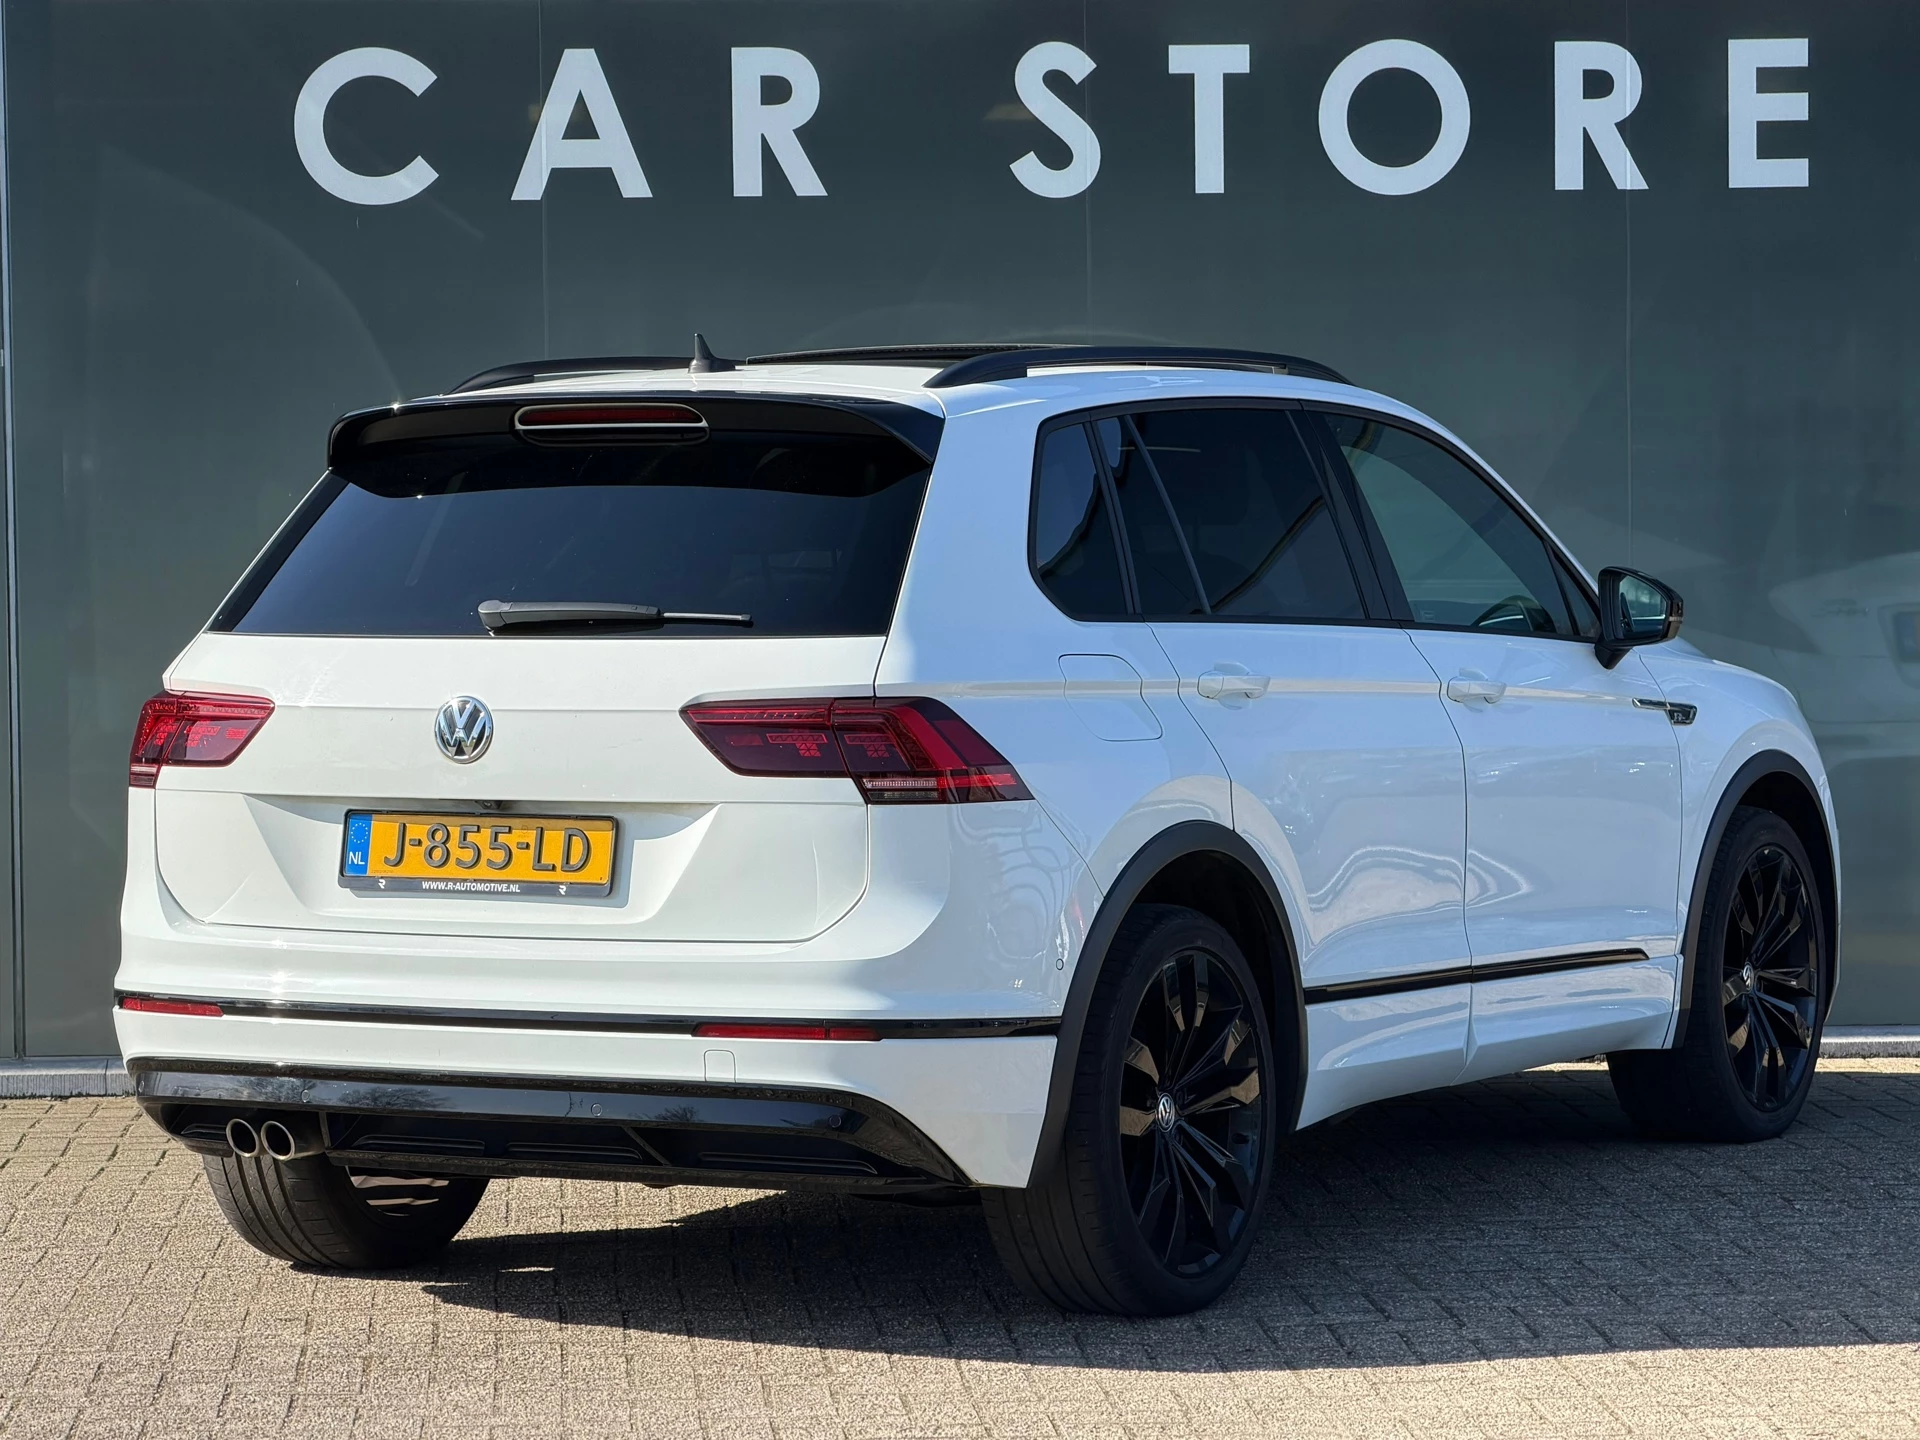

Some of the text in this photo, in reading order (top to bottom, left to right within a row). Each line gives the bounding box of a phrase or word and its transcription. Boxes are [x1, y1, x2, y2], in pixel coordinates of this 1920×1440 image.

[294, 37, 1810, 206] CAR STORE
[348, 851, 365, 866] NL
[383, 822, 592, 873] J-855-LD
[421, 880, 521, 893] WWW.R-AUTOMOTIVE.NL
